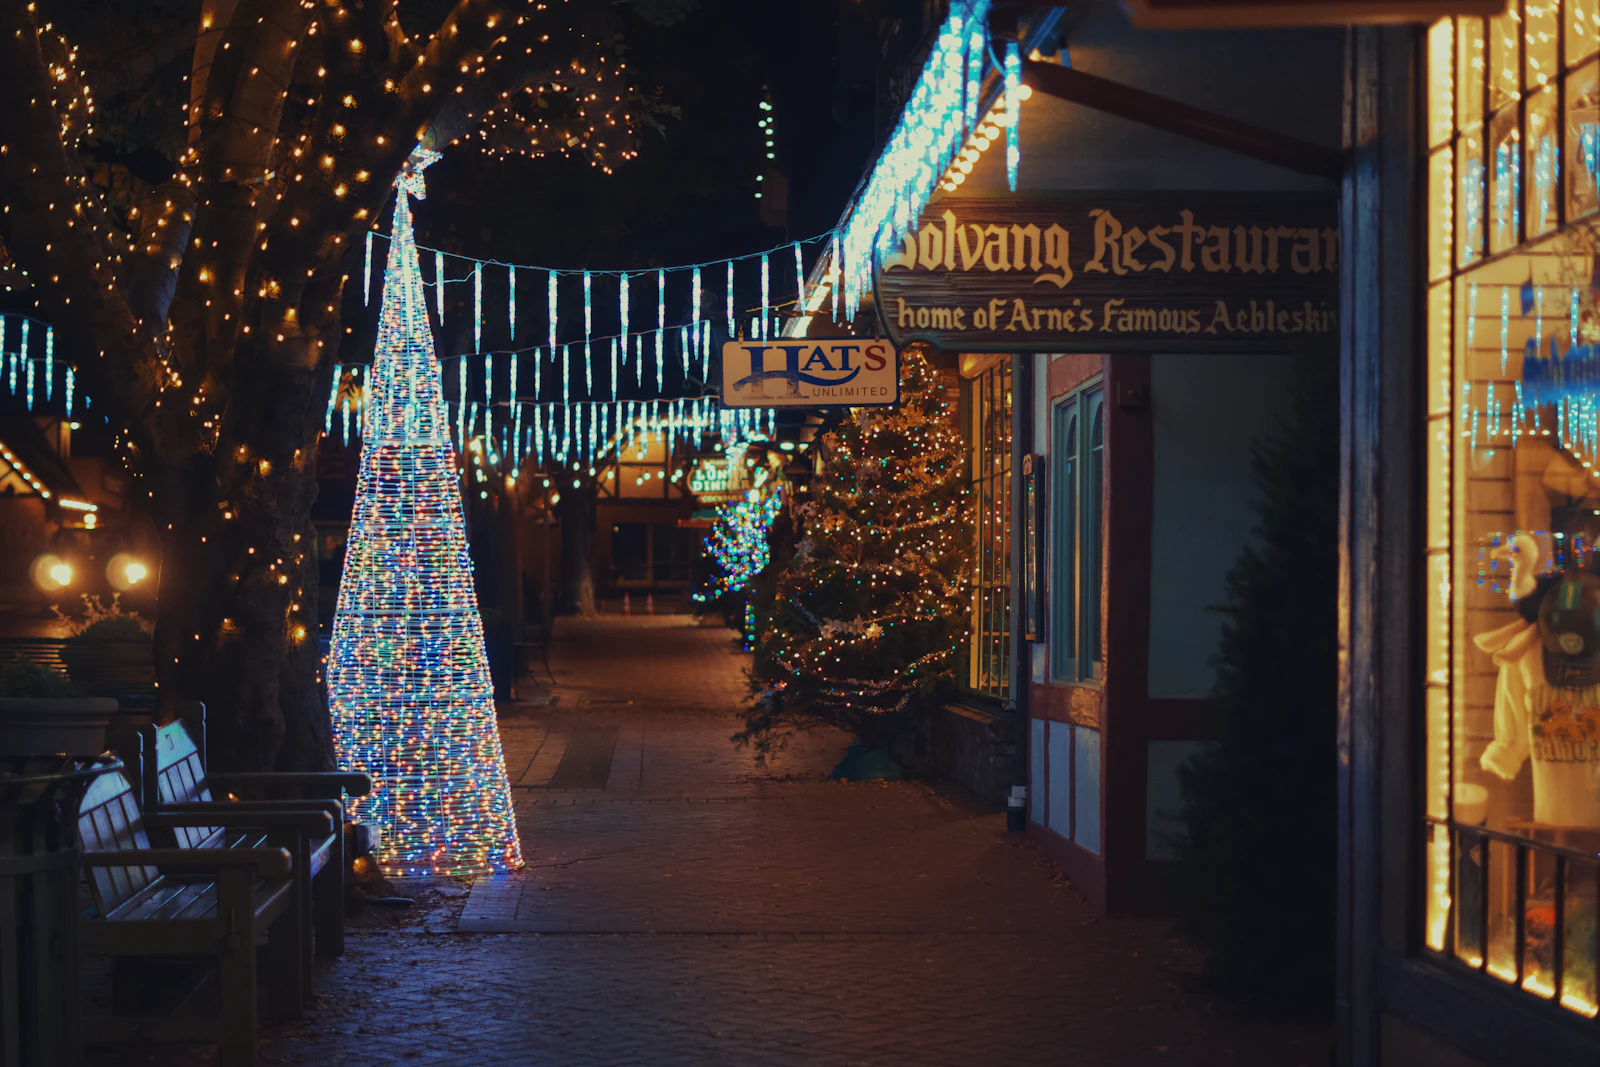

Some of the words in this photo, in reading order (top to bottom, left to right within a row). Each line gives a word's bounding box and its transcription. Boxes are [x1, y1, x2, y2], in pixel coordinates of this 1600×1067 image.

[896, 296, 967, 331] home
[1004, 298, 1094, 332] Arne's
[1099, 298, 1201, 334] Famous
[740, 345, 887, 399] HATS
[812, 386, 888, 397] UNLIMITED
[695, 468, 748, 481] LUNH
